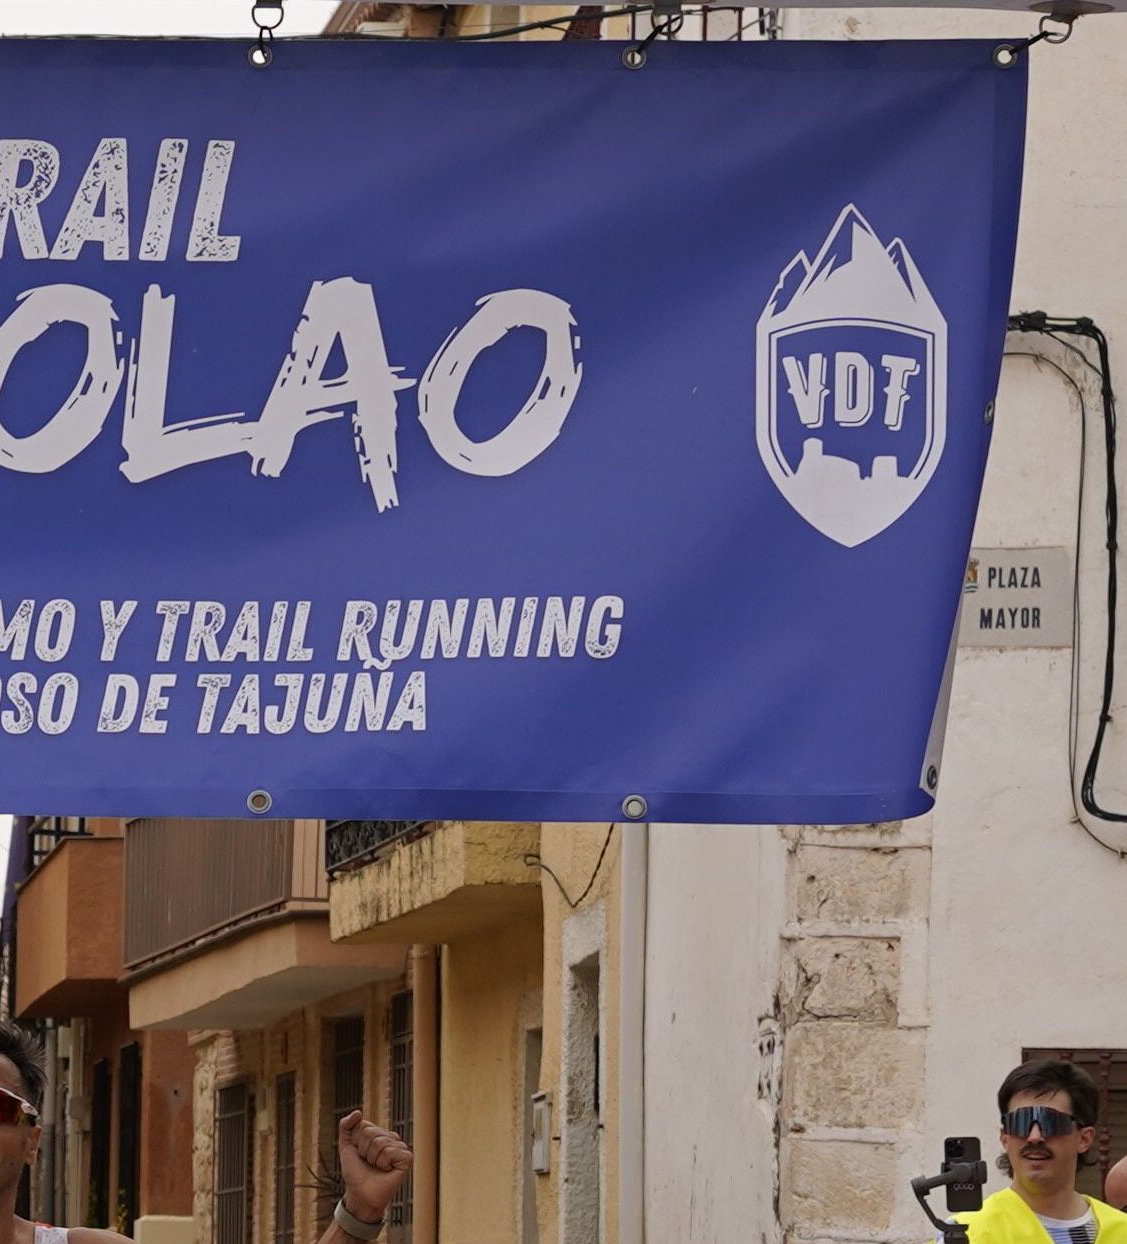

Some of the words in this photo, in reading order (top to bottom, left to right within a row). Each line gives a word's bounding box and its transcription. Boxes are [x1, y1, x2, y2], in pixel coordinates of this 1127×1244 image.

[782, 351, 920, 431] VDT
[987, 566, 1042, 588] PLAZA
[99, 600, 138, 661] Y
[156, 600, 314, 662] TRAIL
[337, 595, 624, 662] RUNNING
[979, 607, 1041, 630] MAYOR
[96, 673, 177, 734] DE
[196, 657, 427, 735] TAJUÑA
